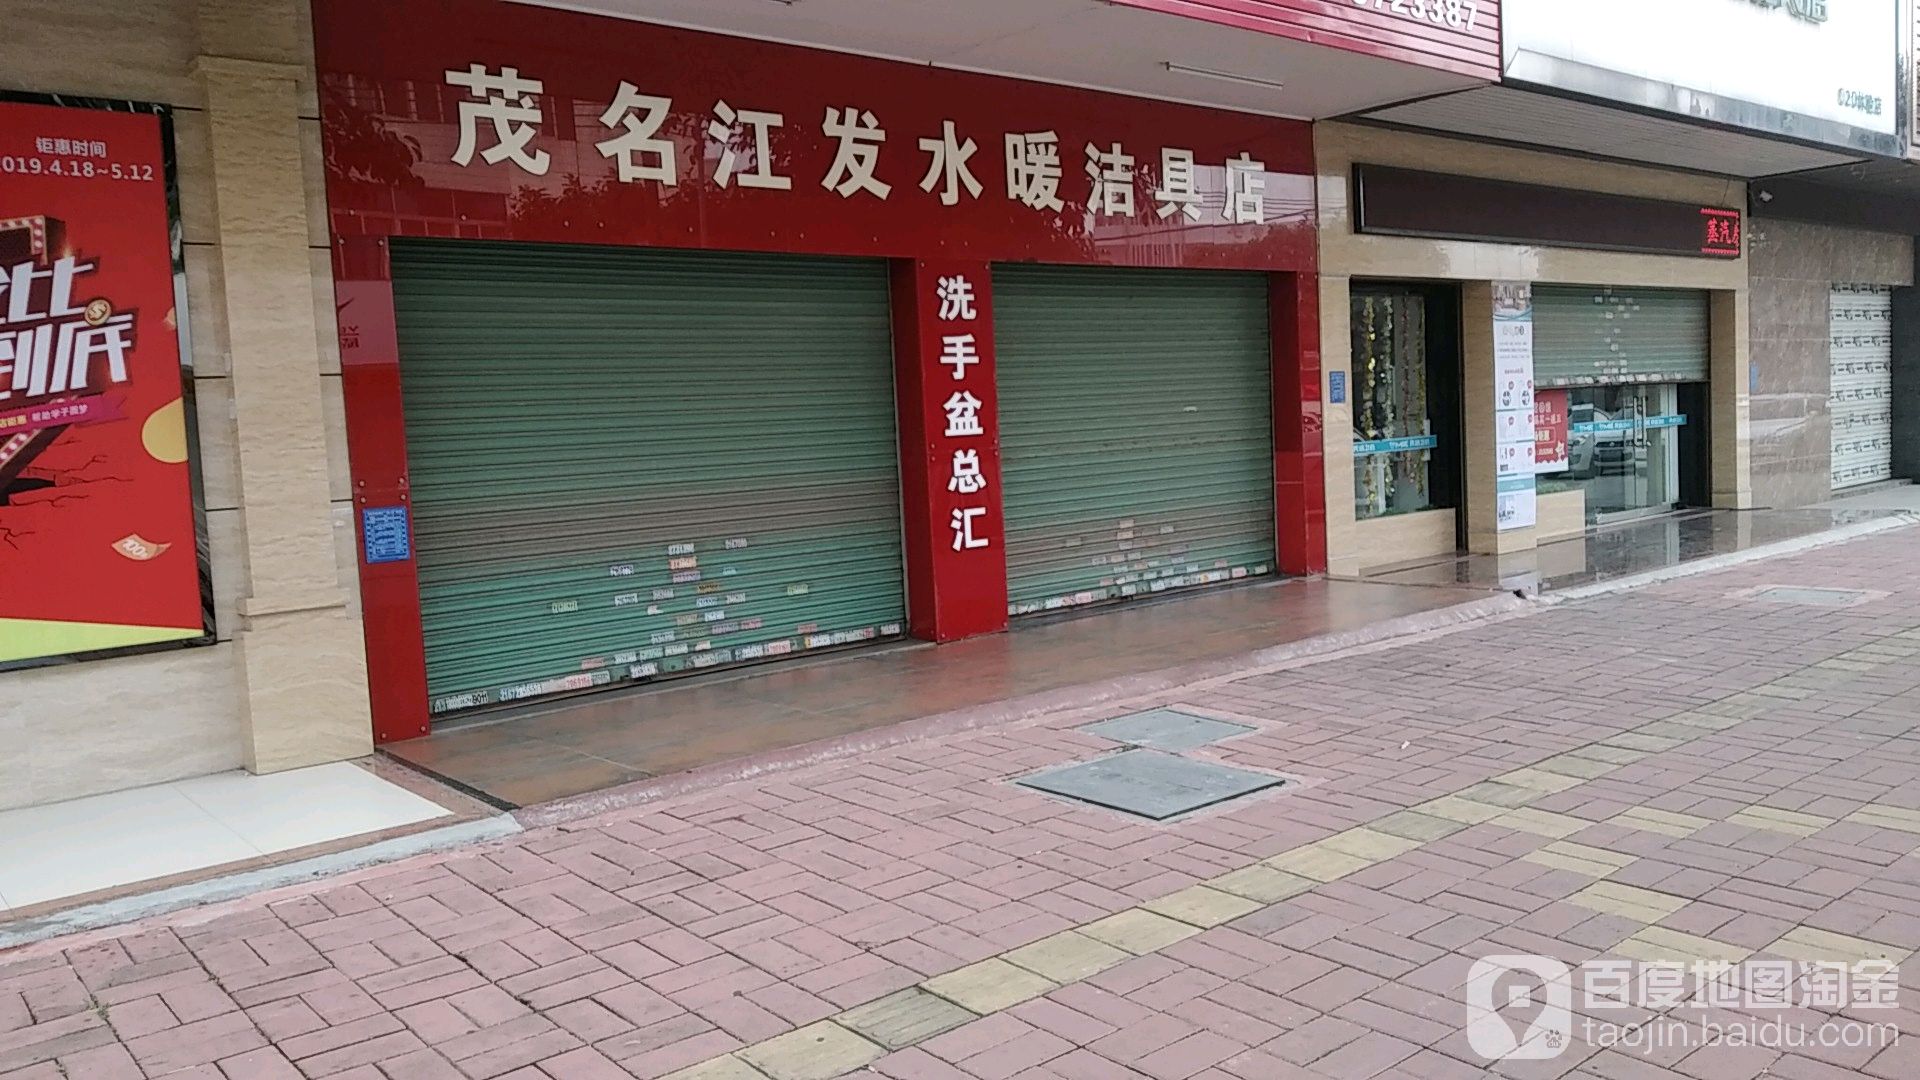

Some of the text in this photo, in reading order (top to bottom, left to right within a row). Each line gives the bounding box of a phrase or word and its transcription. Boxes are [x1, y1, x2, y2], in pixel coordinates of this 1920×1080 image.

[0, 156, 154, 181] 019.4.18~5.12
[36, 136, 107, 158] 钜惠时间
[445, 63, 1266, 226] 茂名江发水暖洁具店
[936, 274, 989, 552] 洗手盆总汇
